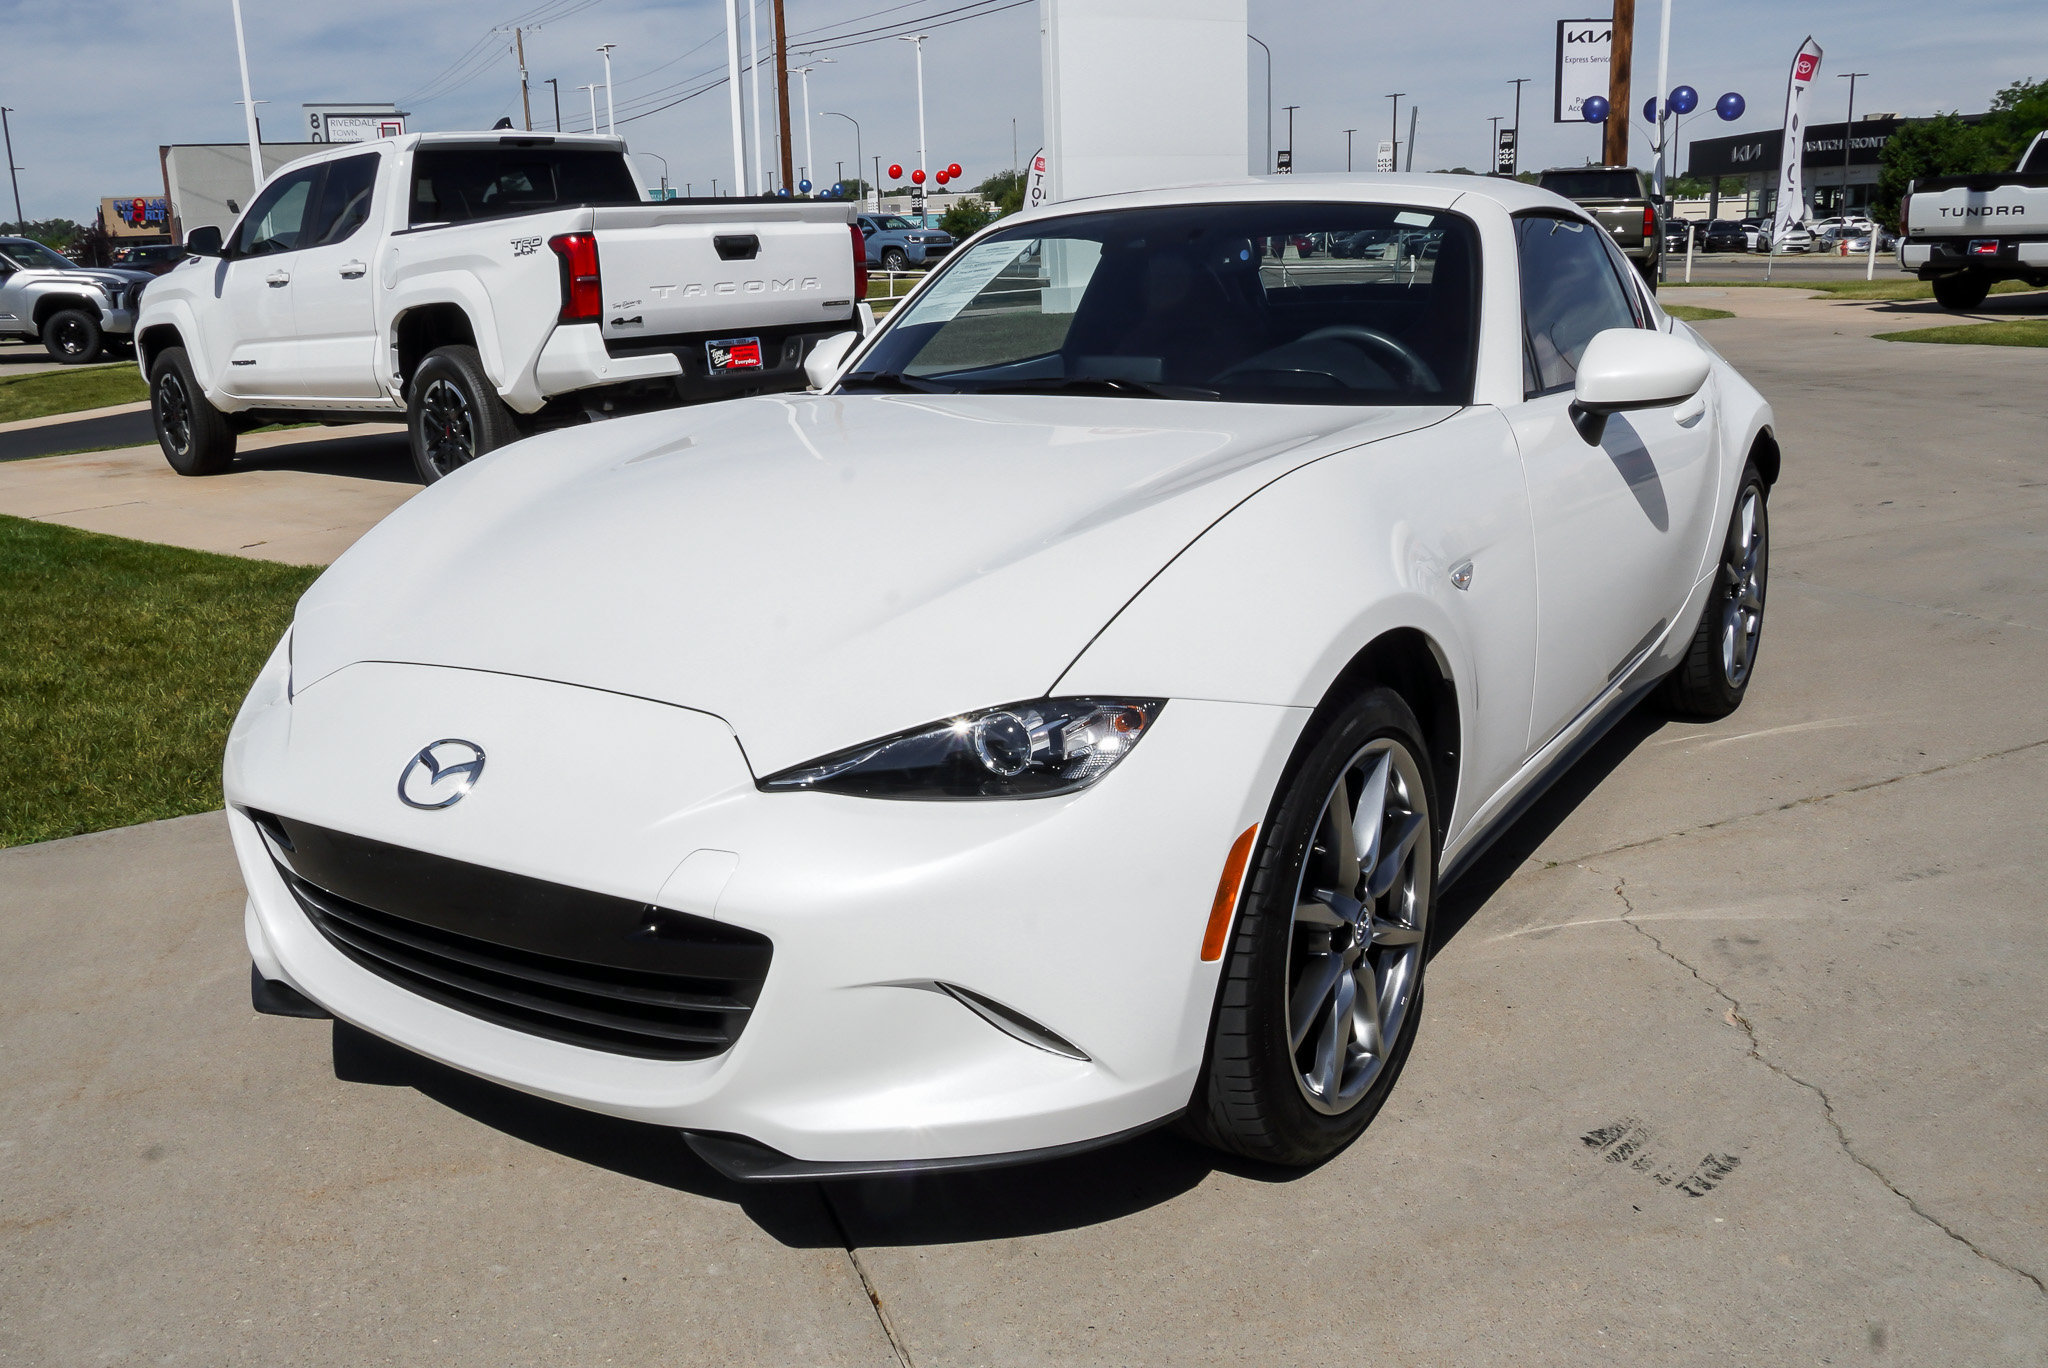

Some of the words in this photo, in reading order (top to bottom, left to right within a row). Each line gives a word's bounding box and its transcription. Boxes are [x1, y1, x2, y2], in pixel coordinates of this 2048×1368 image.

[1565, 56, 1589, 65] Express
[330, 119, 377, 127] RIVERDALE
[1731, 143, 1762, 163] KIA
[1802, 140, 1843, 153] ASATCH
[1939, 205, 2025, 218] TUNDRA
[510, 235, 543, 251] TRD
[650, 277, 822, 299] TACOMA
